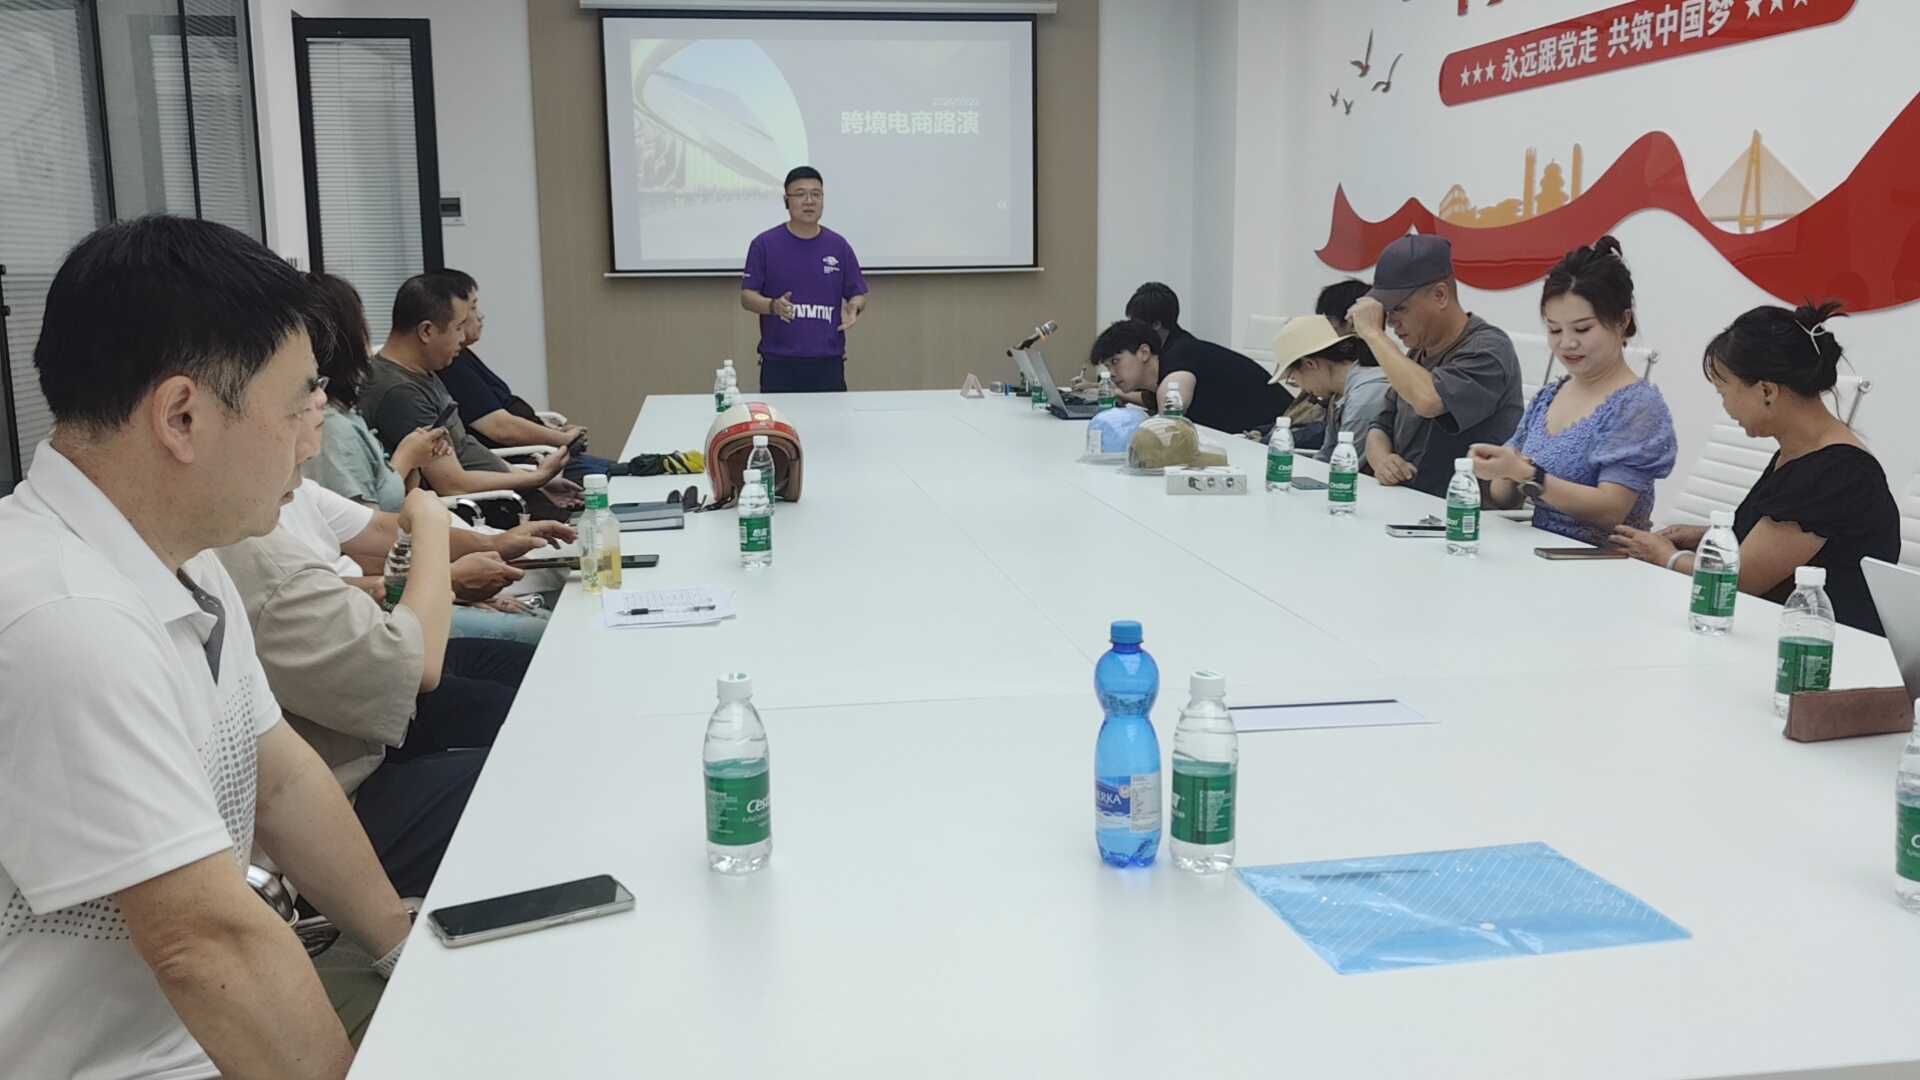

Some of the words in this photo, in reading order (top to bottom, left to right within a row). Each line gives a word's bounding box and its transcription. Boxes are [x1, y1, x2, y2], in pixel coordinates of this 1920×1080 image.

[1501, 26, 1598, 82] 永远跟党走
[1608, 0, 1734, 58] 共筑中国梦
[841, 110, 980, 134] 跨境电商路演
